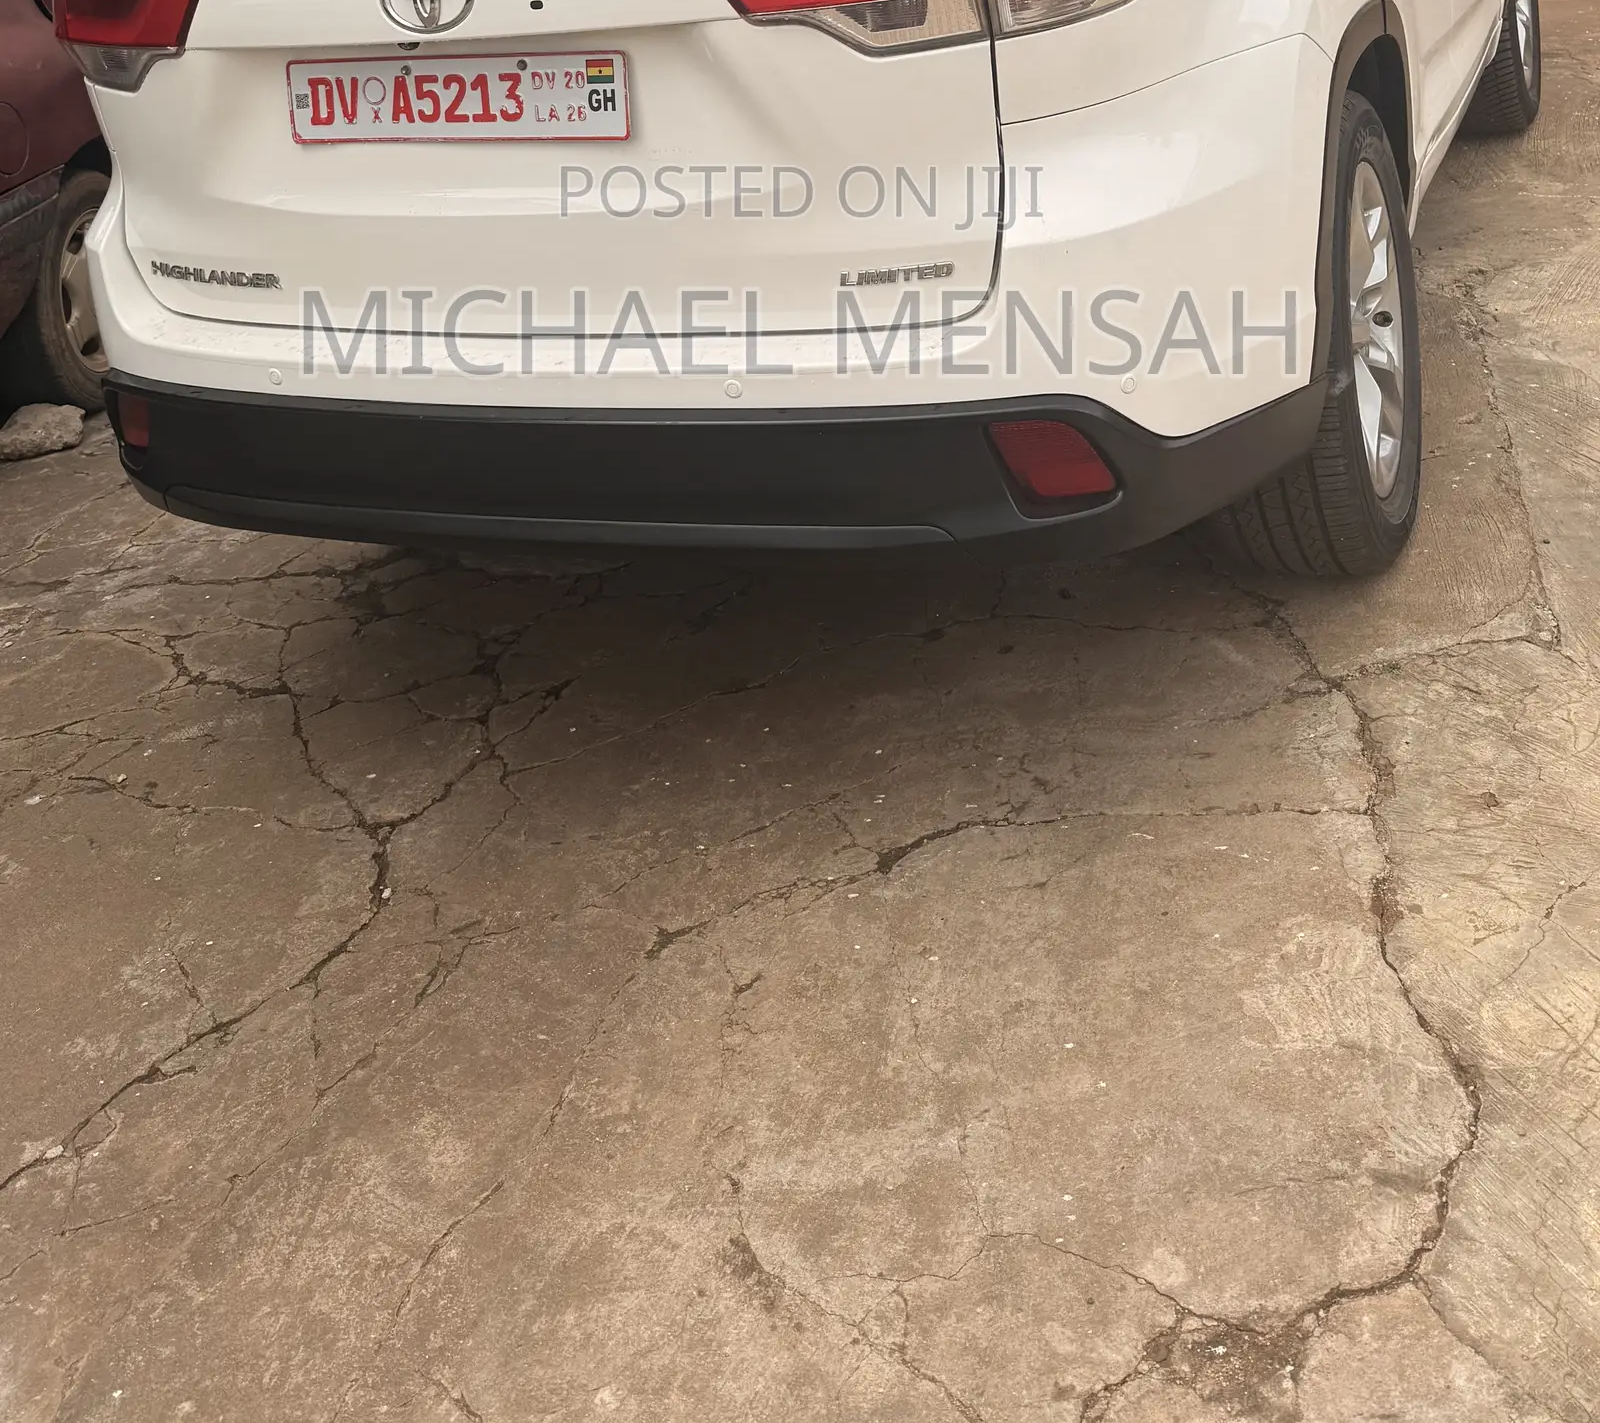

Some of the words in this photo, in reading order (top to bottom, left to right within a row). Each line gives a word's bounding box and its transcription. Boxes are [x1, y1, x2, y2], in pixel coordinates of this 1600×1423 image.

[531, 70, 556, 90] DV
[564, 70, 585, 89] 20
[307, 75, 359, 126] DV
[391, 72, 525, 125] A5213
[588, 88, 616, 112] GH
[534, 103, 560, 122] LA
[566, 103, 587, 122] 26
[151, 260, 284, 290] HIGHLANDER
[839, 260, 956, 287] LIMITED
